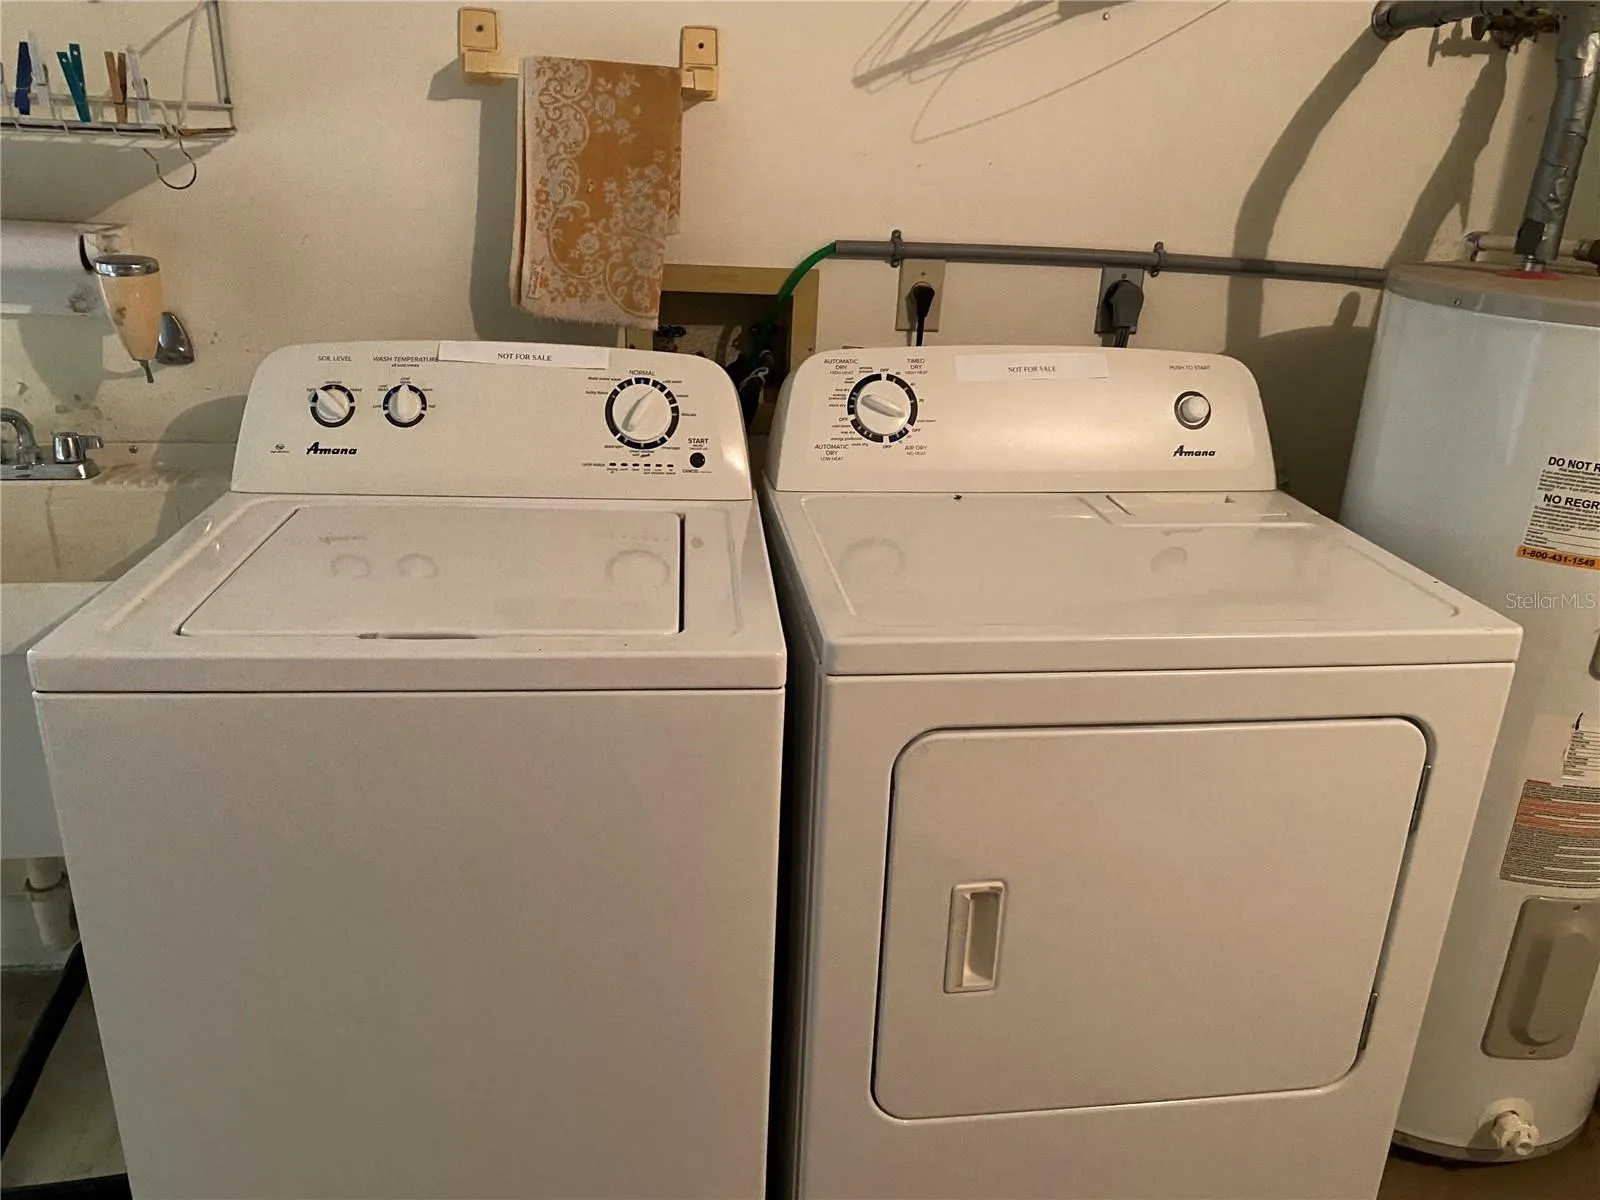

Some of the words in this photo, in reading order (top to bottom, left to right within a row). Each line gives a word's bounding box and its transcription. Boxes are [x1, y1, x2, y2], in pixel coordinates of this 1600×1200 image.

[497, 352, 514, 360] NOT
[306, 441, 357, 455] Amana
[1172, 445, 1216, 457] Amana
[1548, 456, 1565, 467] DO
[1567, 459, 1592, 471] NOT
[1543, 493, 1562, 504] NO
[1521, 548, 1596, 567] 1-800-431-1549
